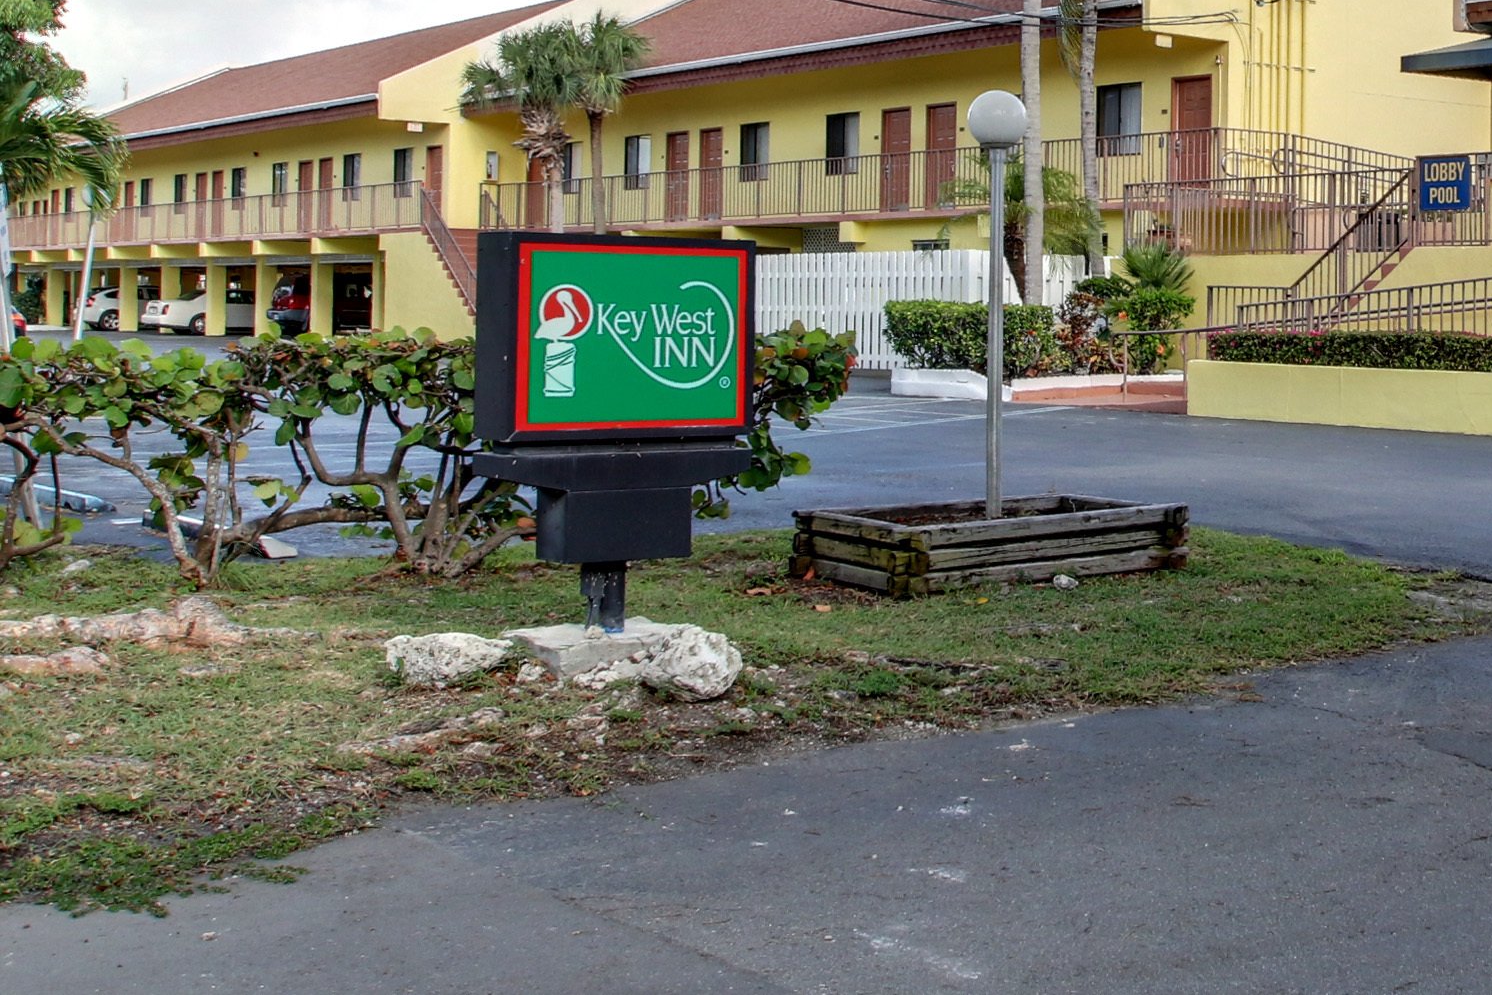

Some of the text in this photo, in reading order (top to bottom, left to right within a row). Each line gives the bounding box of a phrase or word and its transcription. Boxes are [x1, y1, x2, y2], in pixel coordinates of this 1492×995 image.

[1424, 161, 1465, 182] LOBBY
[1429, 186, 1460, 204] POOL
[596, 303, 716, 342] Key West
[652, 336, 716, 369] INN
